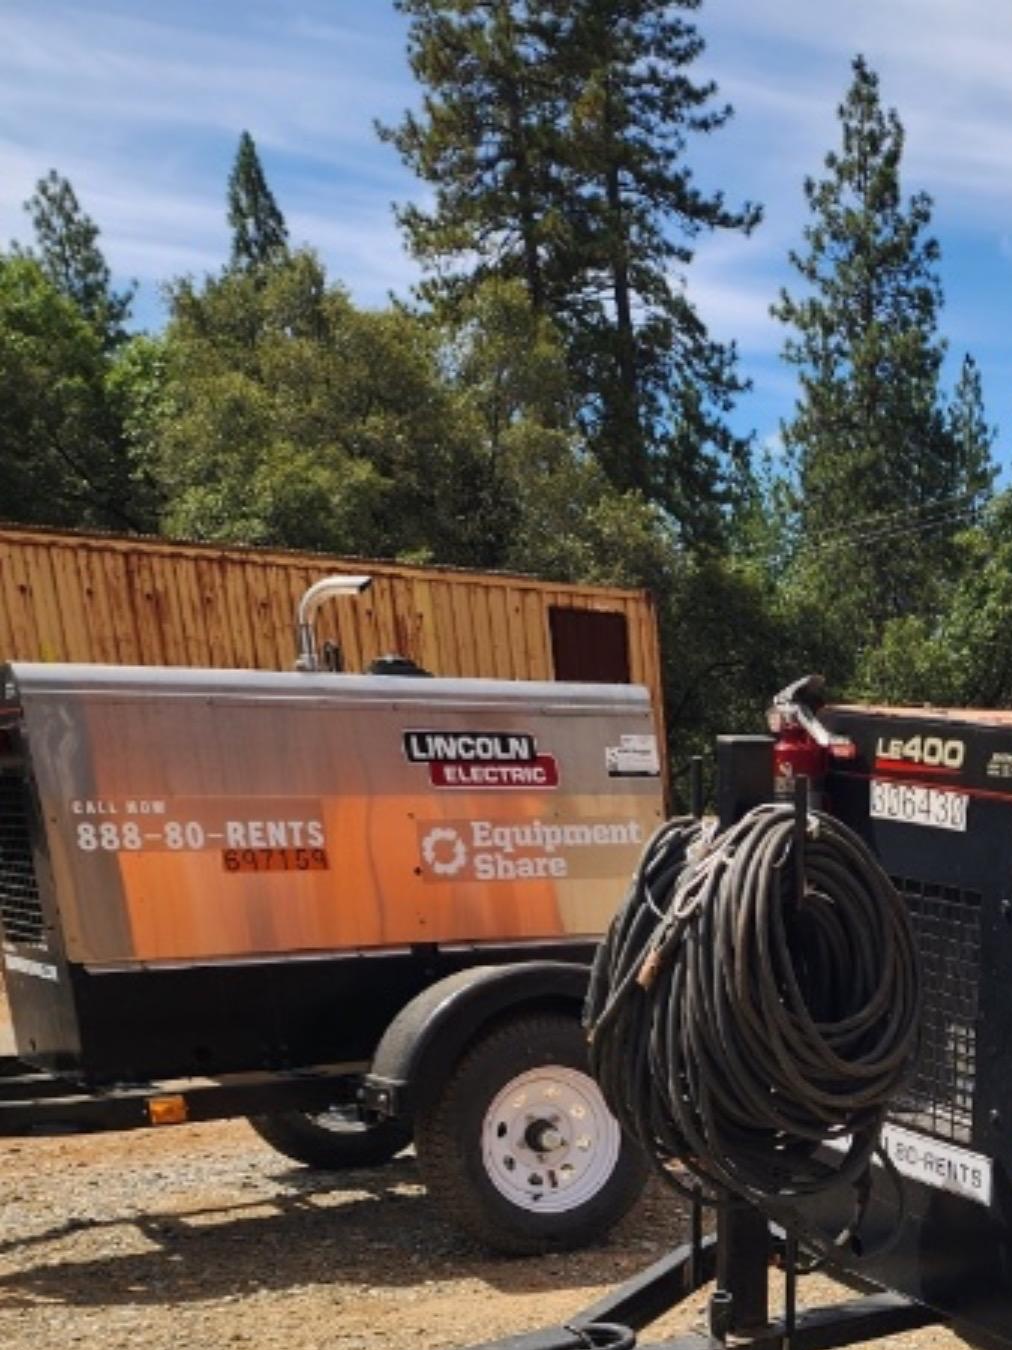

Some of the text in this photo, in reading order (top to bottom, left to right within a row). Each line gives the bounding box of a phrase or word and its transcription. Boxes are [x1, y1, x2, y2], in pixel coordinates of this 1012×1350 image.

[409, 734, 530, 760] LINCOLN
[442, 764, 547, 785] ELECTRIC
[73, 800, 166, 814] CALL NOW
[77, 820, 325, 851] 888-80-RENTS
[470, 819, 642, 853] Equipment
[223, 849, 329, 871] 697159
[473, 854, 568, 880] Share
[886, 1137, 983, 1189] 80-RENTS
